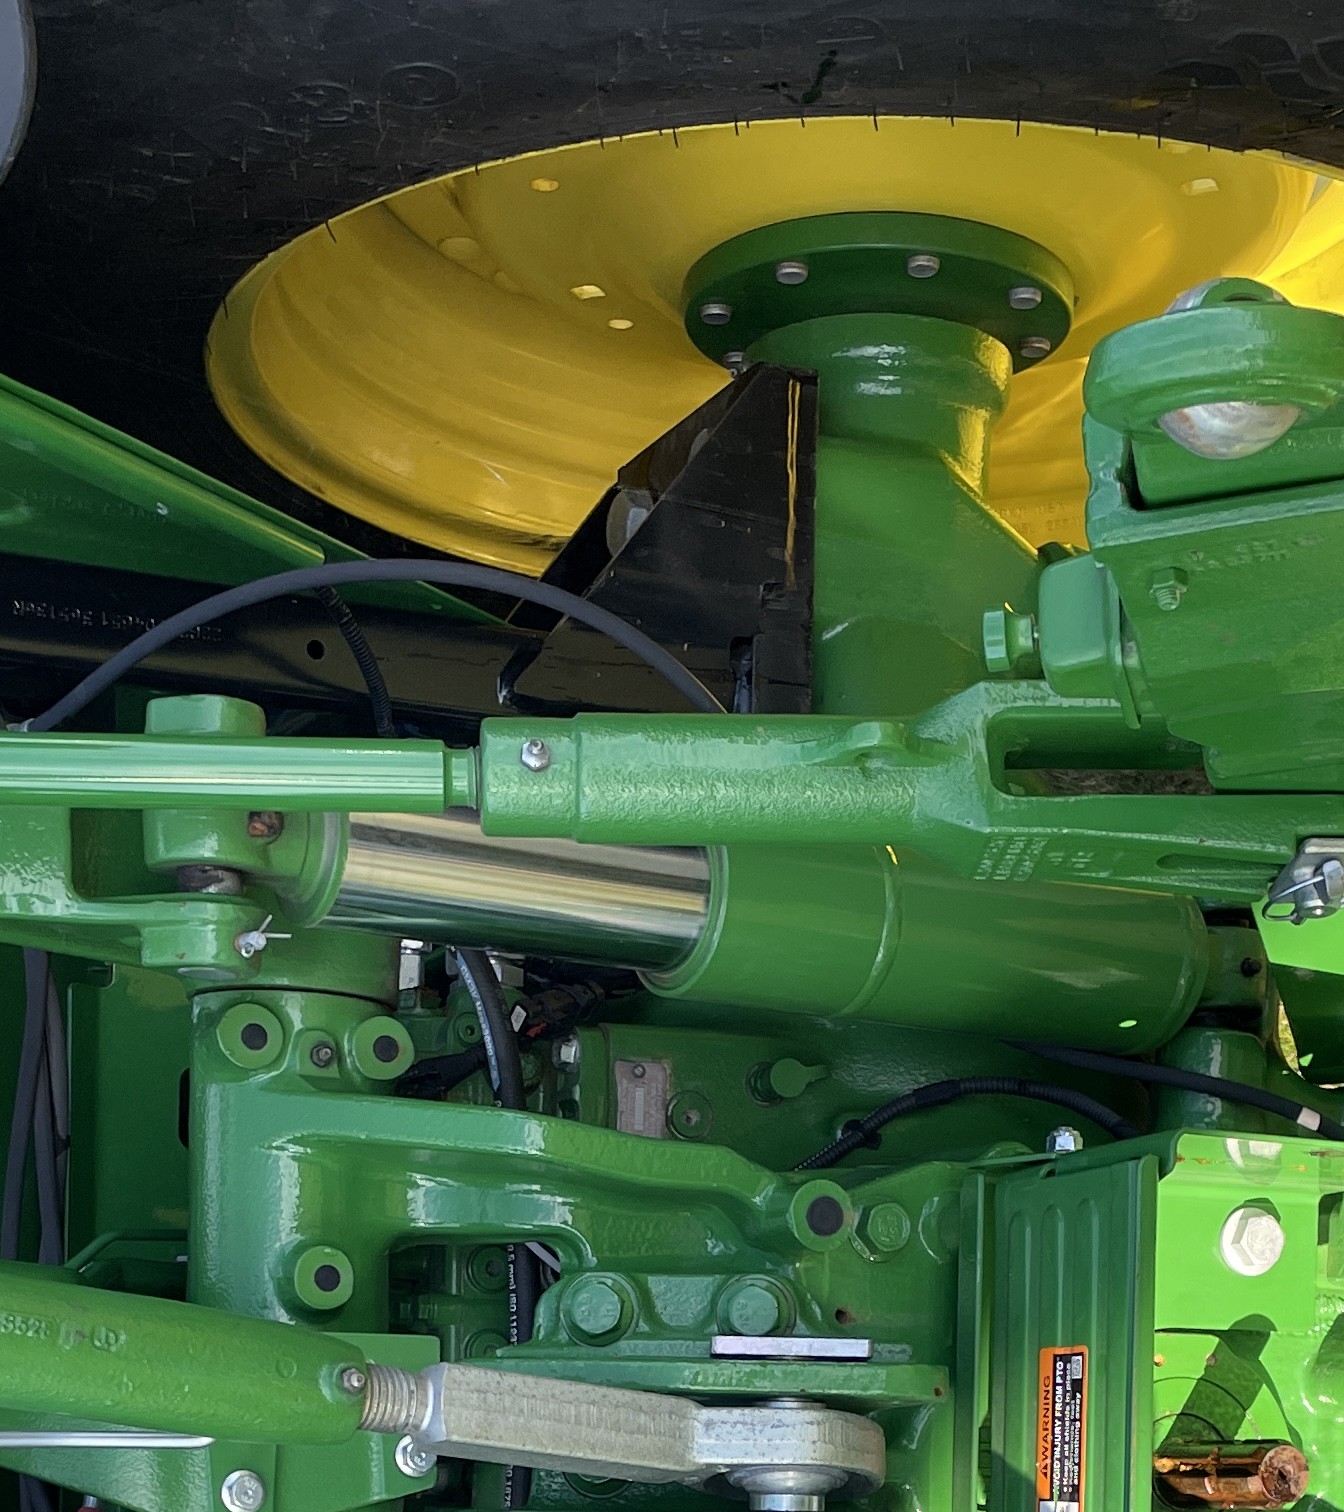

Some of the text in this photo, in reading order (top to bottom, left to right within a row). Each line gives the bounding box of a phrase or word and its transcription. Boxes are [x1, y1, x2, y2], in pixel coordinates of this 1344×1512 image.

[509, 1293, 517, 1312] ISO
[1056, 1362, 1064, 1384] PTO
[1054, 1386, 1063, 1417] FROM
[1040, 1374, 1051, 1463] WARNING
[1054, 1419, 1062, 1458] INJURY
[1073, 1421, 1081, 1464] clothing
[1062, 1458, 1070, 1484] Keep
